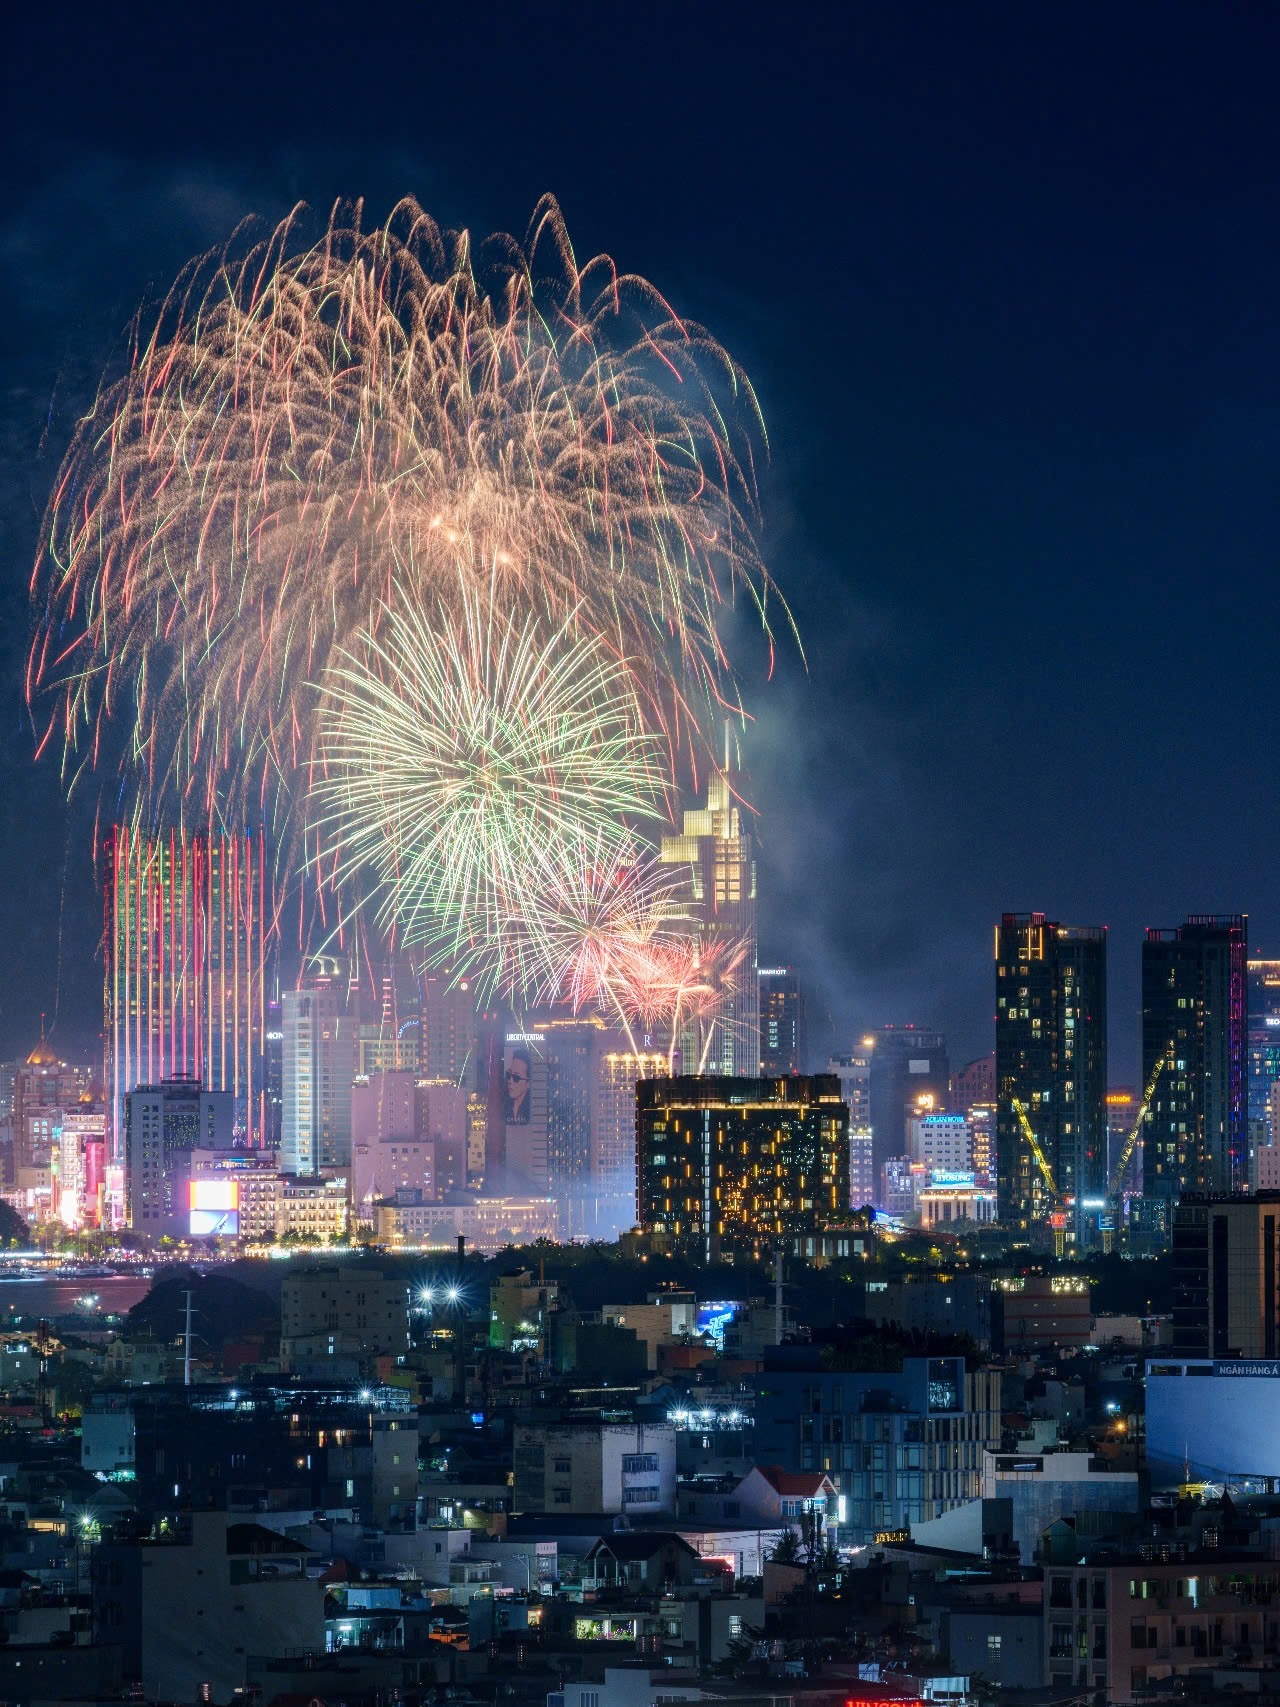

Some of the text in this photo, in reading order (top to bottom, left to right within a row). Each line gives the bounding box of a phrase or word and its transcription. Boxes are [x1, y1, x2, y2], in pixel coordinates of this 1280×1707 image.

[643, 1034, 652, 1047] R
[936, 1174, 971, 1182] HYOSUNG
[1219, 1364, 1246, 1375] NGÂN
[1245, 1364, 1271, 1375] HÀNG
[1271, 1364, 1279, 1375] Á
